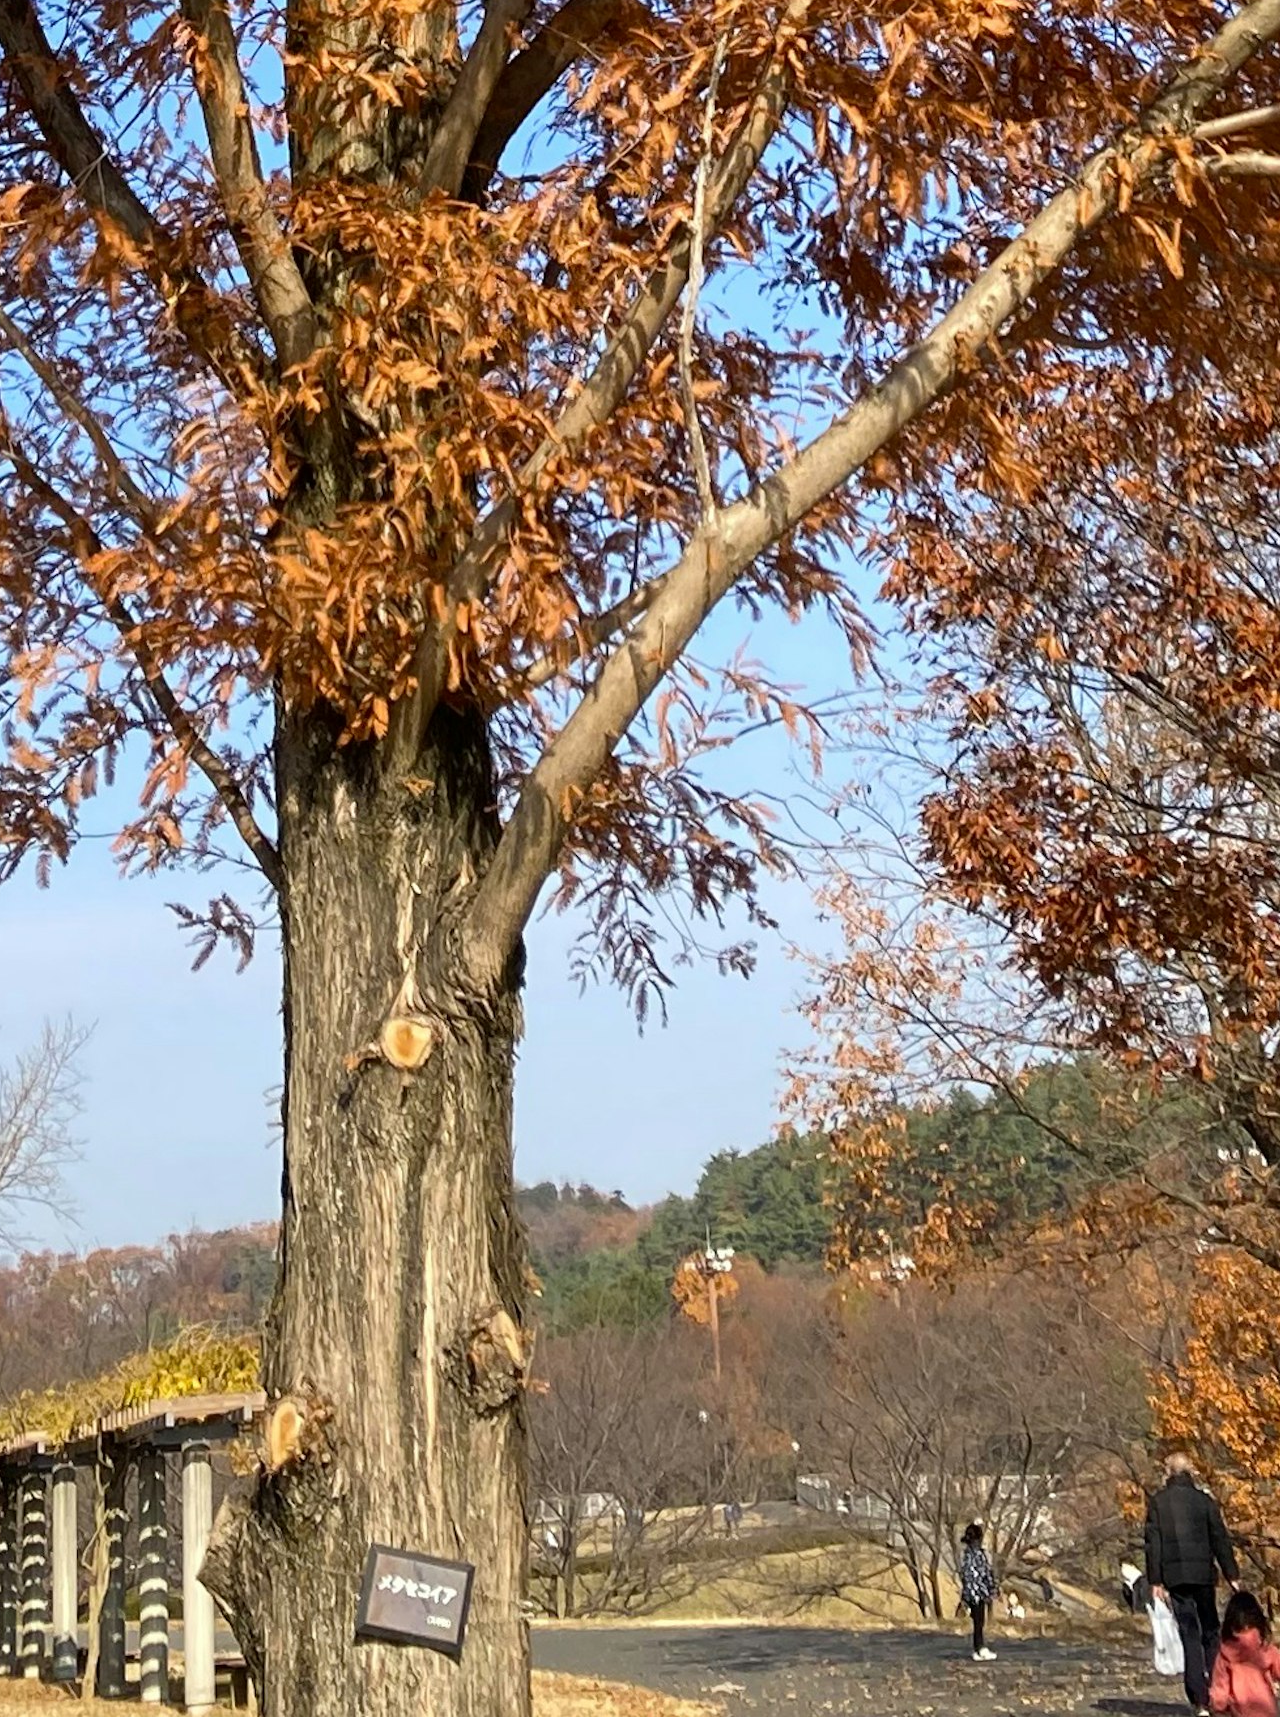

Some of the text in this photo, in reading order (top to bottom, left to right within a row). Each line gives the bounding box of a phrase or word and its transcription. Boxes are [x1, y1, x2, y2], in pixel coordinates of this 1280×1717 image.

[378, 1574, 458, 1604] メタセコイア
